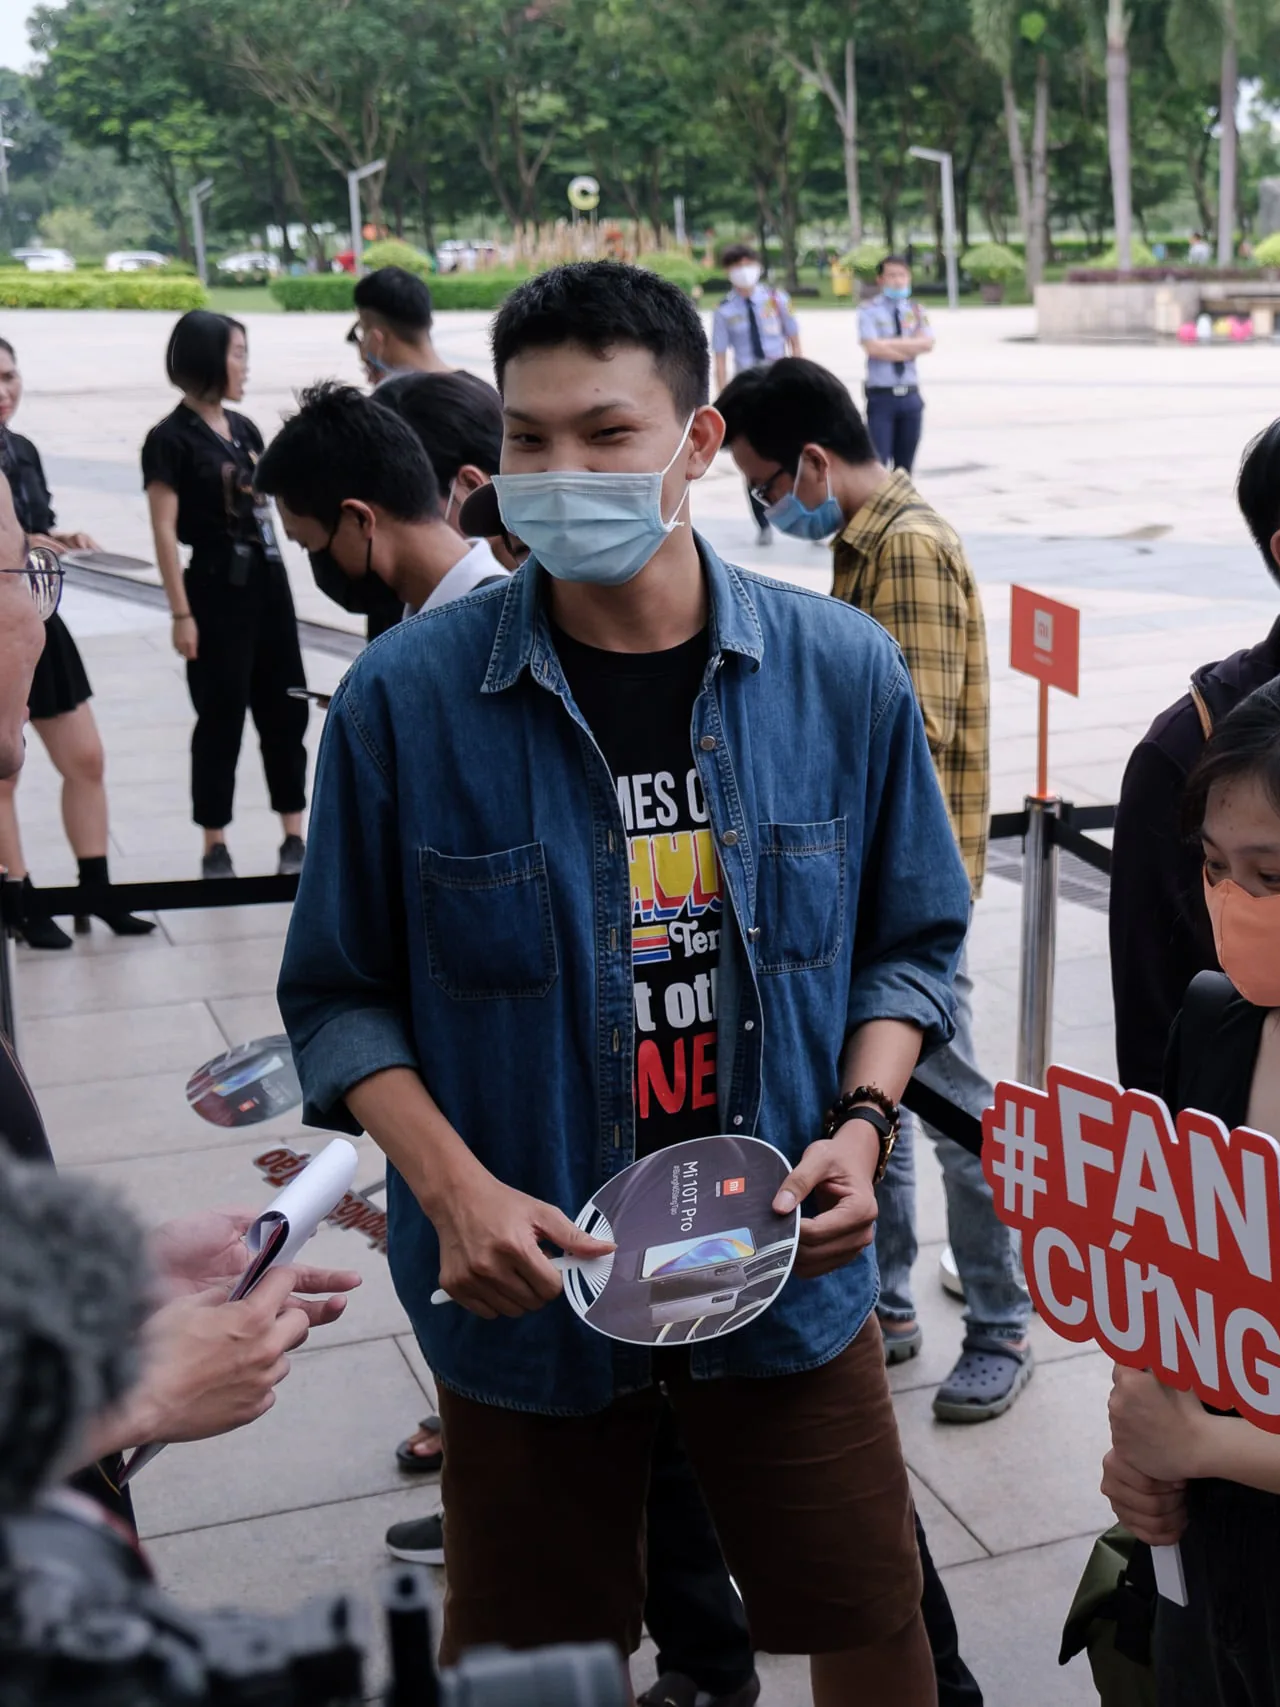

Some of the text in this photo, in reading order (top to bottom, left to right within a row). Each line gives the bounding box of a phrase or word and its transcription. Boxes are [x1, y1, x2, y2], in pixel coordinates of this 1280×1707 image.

[632, 1032, 717, 1119] NE
[680, 1160, 699, 1232] Mi 10T Pro
[992, 1084, 1272, 1282] #FAN
